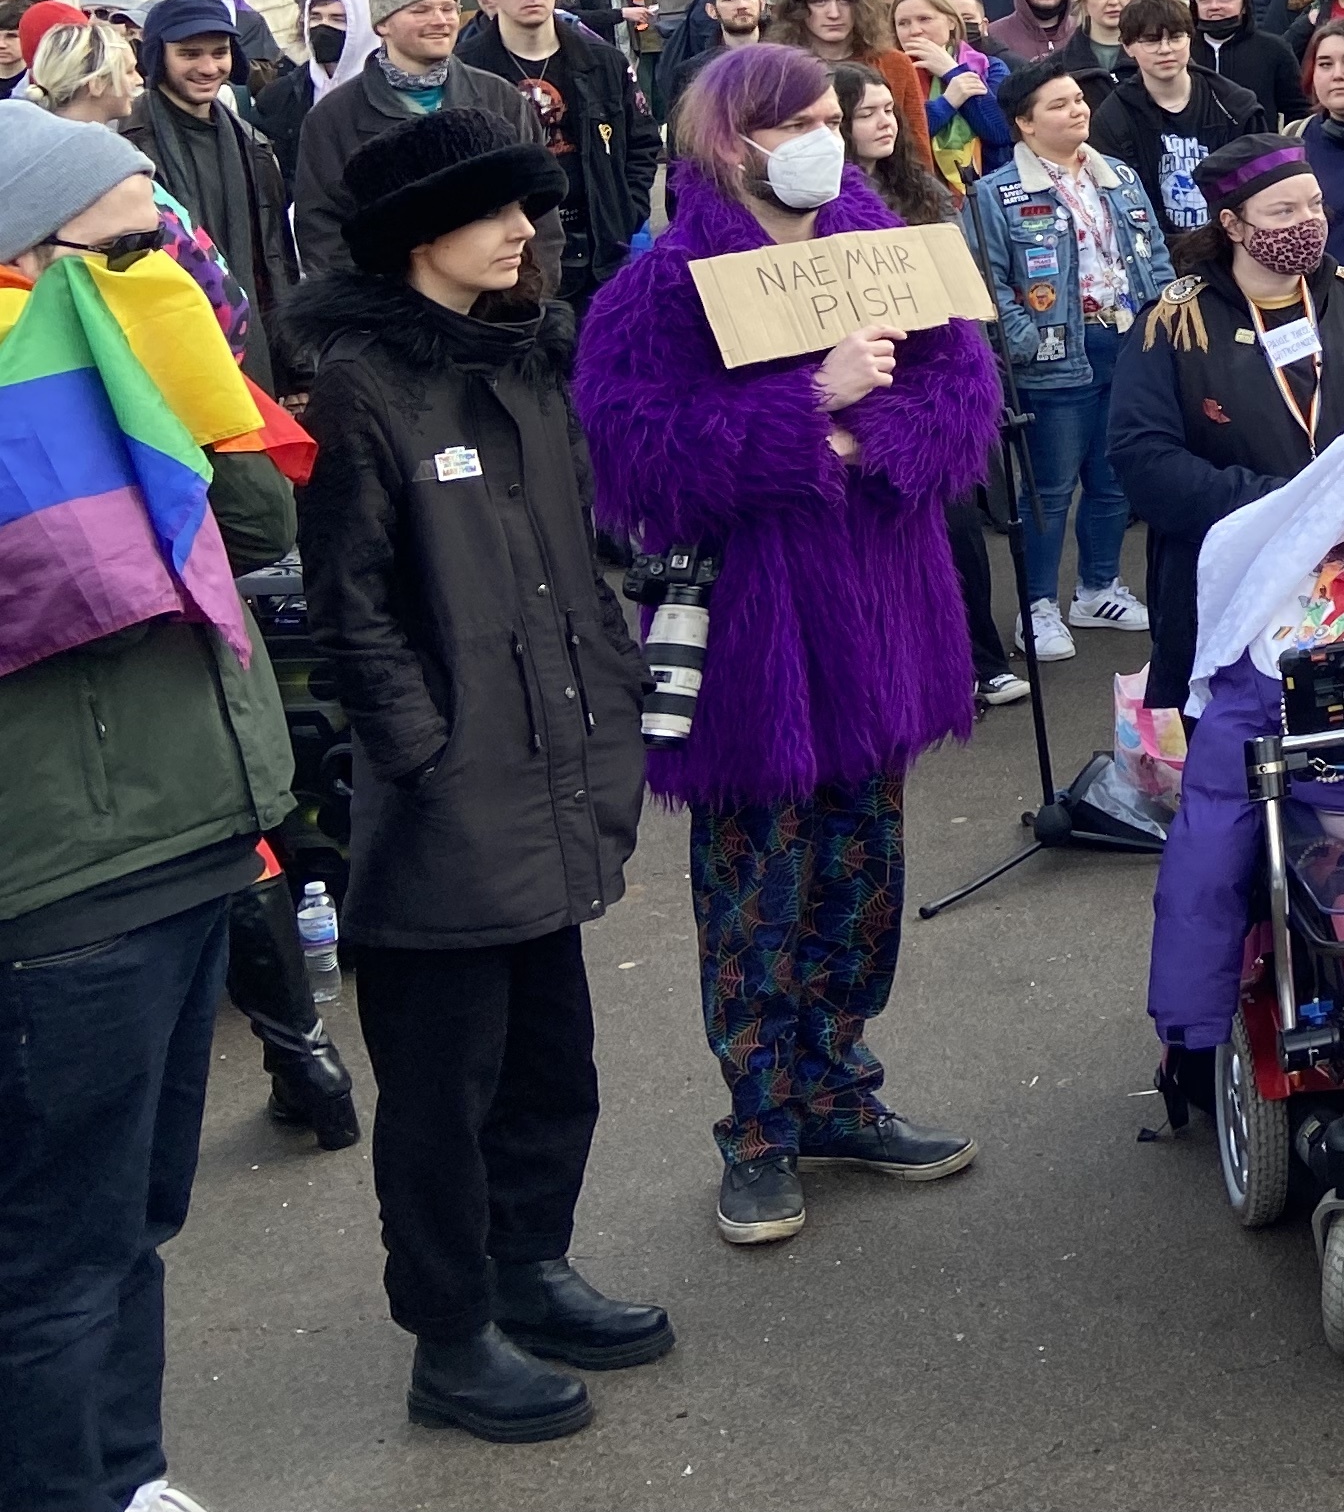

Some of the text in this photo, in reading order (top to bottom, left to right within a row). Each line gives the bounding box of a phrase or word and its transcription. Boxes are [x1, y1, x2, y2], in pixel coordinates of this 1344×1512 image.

[1000, 183, 1021, 192] BLAC
[756, 245, 916, 295] NAE MAIR
[811, 282, 919, 329] PISH
